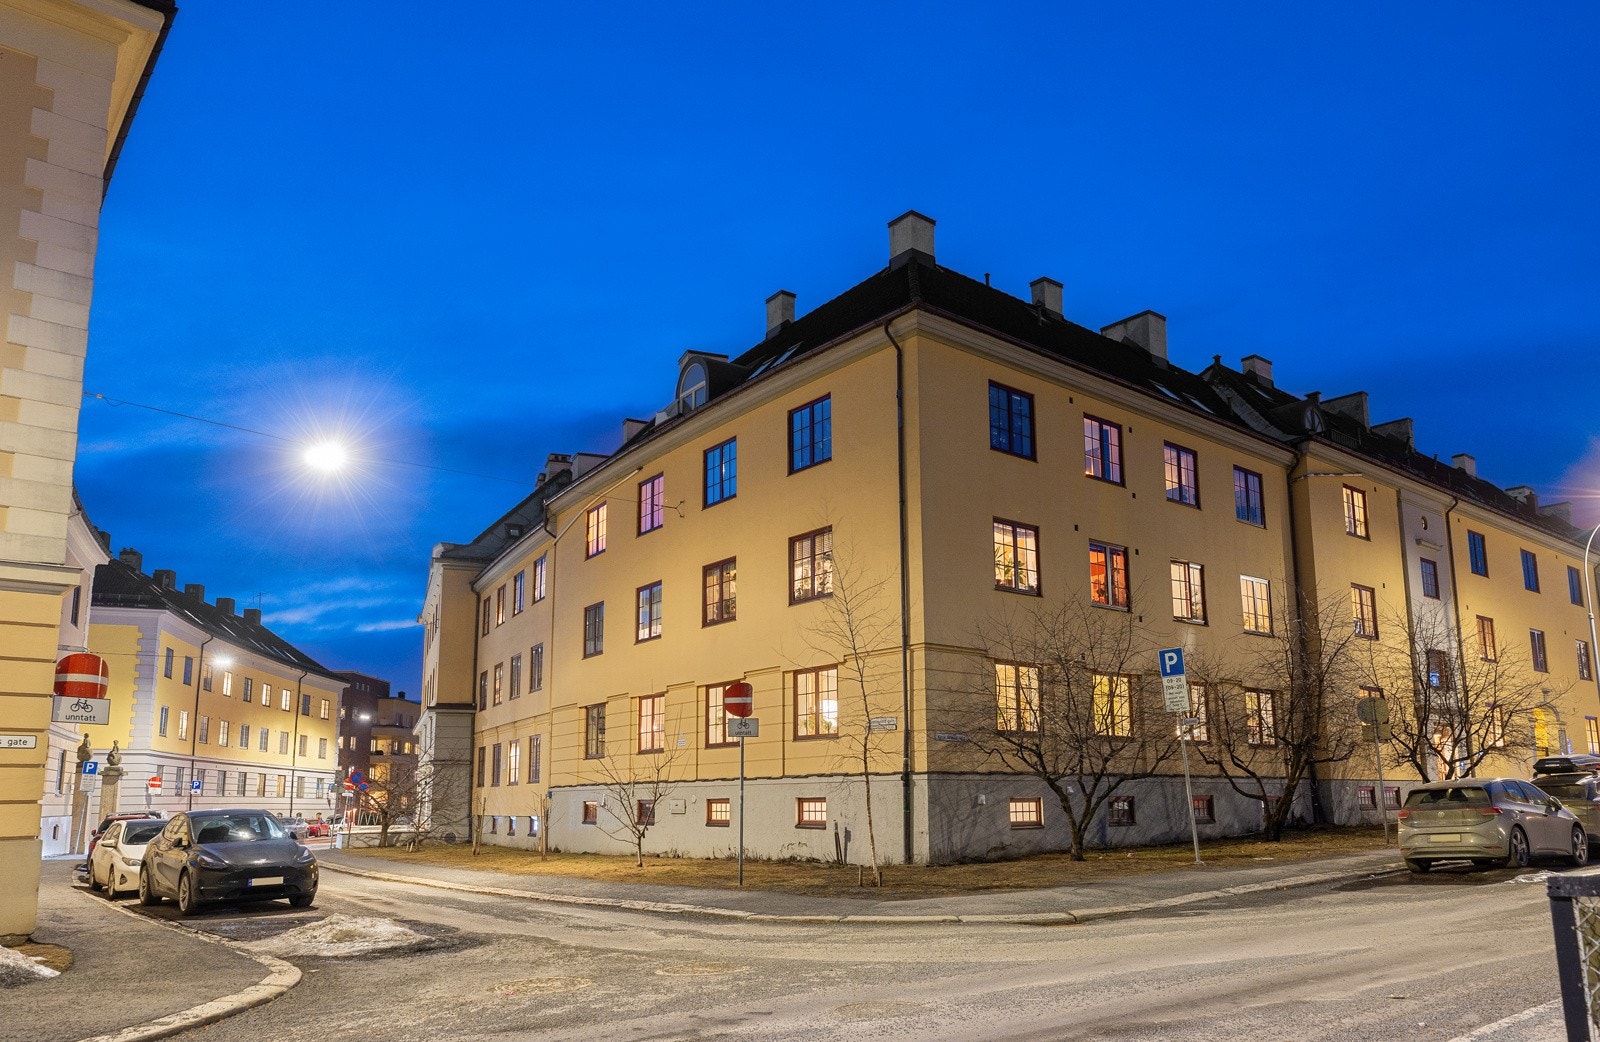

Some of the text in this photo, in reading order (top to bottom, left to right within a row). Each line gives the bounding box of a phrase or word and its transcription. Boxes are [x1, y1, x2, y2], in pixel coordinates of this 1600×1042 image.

[1164, 652, 1178, 674] P
[65, 713, 97, 722] unntatt
[7, 739, 28, 747] gate
[86, 762, 95, 773] P
[193, 781, 200, 790] P
